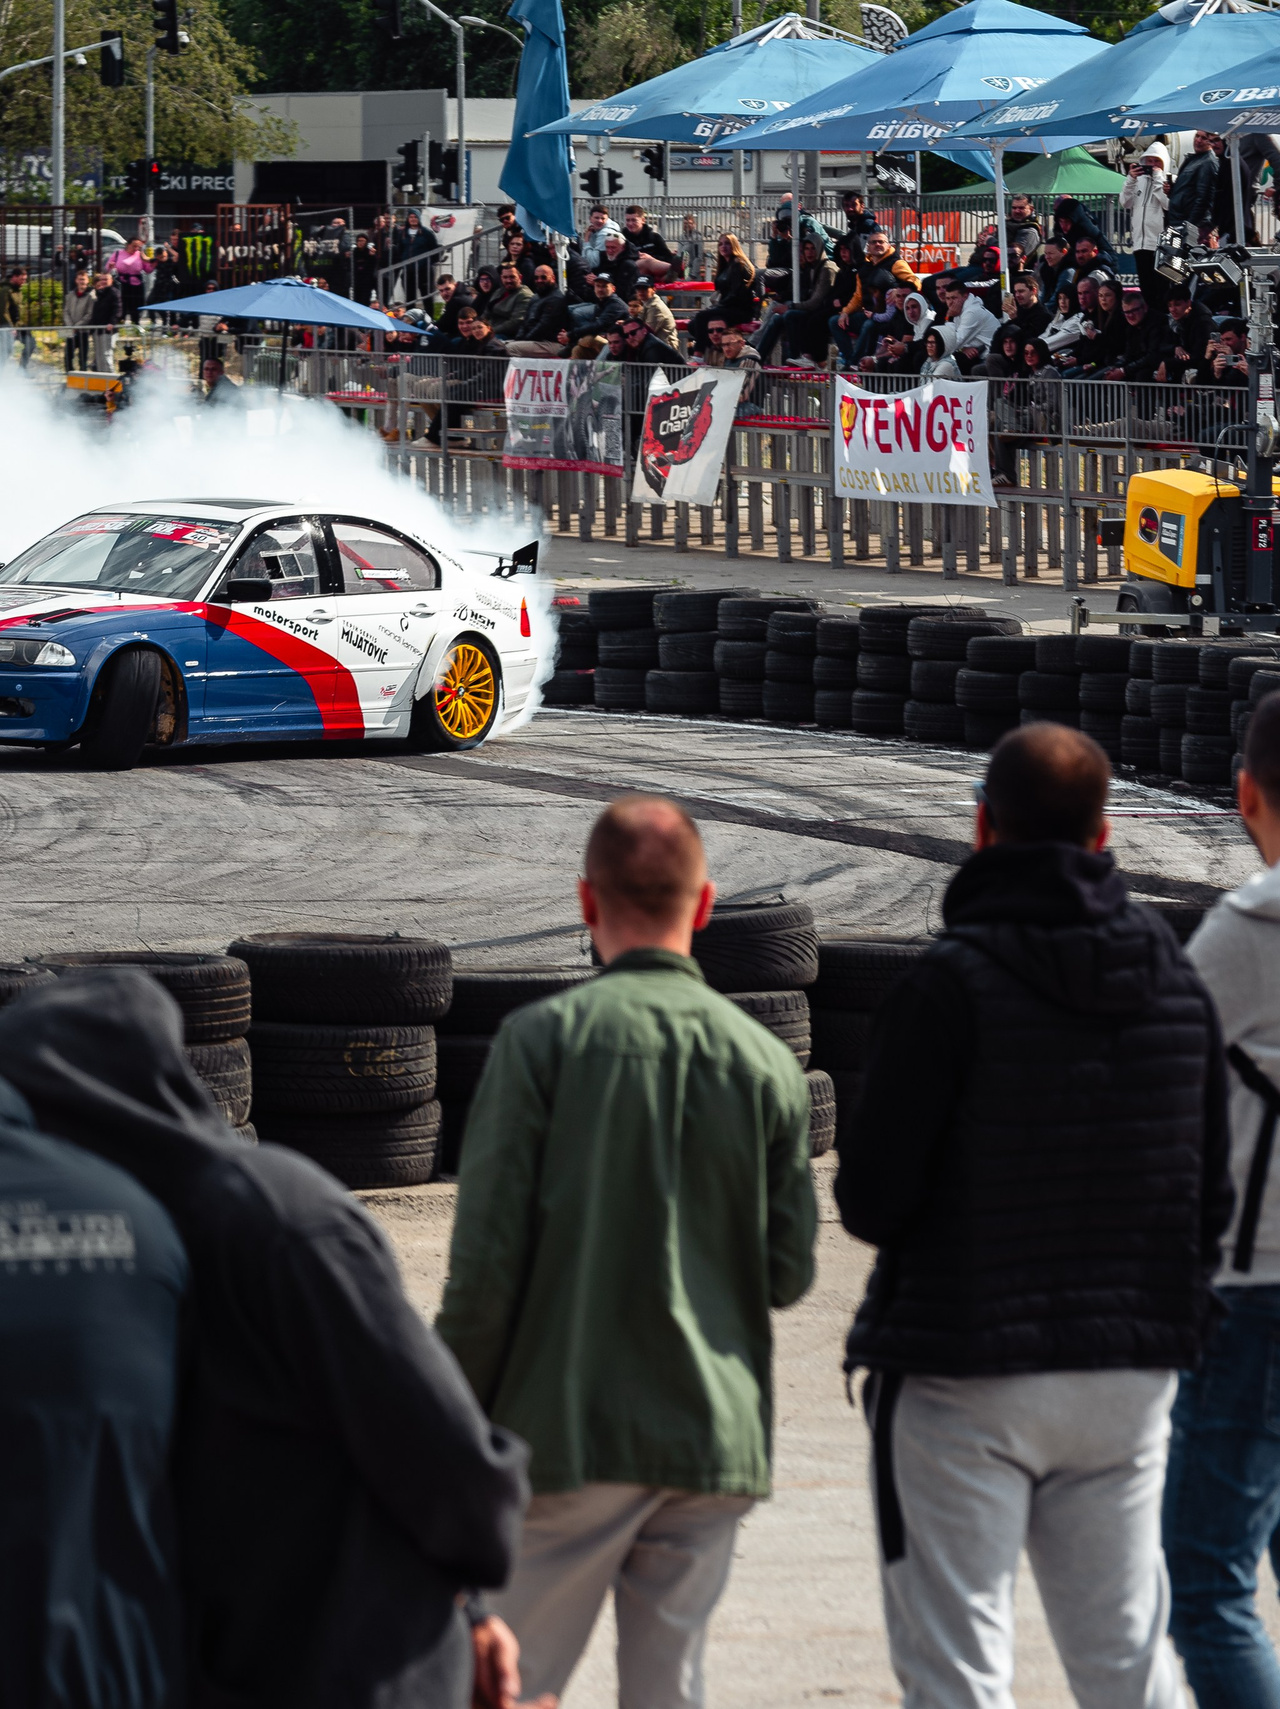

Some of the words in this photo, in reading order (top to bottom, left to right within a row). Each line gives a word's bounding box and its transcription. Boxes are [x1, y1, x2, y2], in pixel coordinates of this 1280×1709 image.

[692, 157, 721, 166] GARAGE
[191, 176, 235, 190] PREG
[659, 418, 689, 436] Chan
[857, 394, 967, 454] TENGE
[839, 465, 920, 494] GOSPODARI
[923, 471, 981, 494] VISINE
[253, 605, 319, 642] motorsport
[341, 627, 389, 665] MIJATOVIĆ
